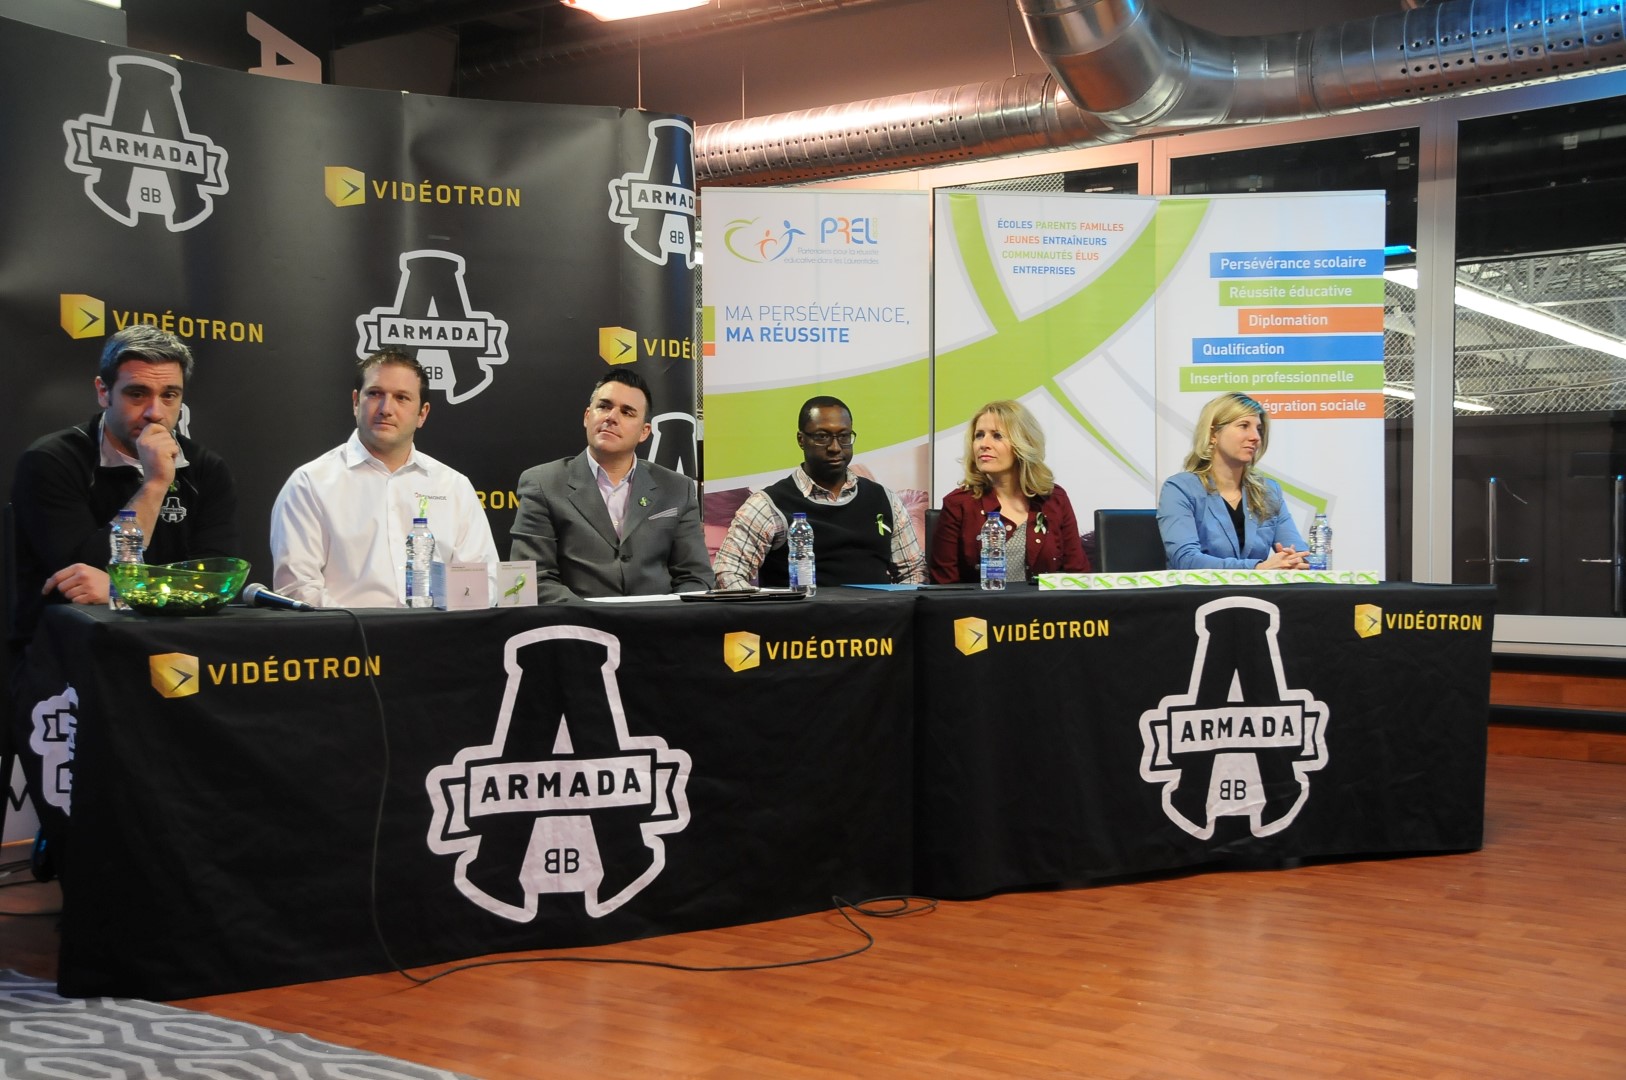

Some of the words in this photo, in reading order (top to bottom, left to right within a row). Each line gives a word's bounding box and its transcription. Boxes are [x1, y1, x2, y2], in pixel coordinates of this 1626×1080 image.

[99, 135, 198, 167] ARMADA
[140, 187, 162, 203] BB
[372, 179, 520, 207] VIDÉOTRON
[820, 217, 877, 244] PREL
[997, 218, 1033, 229] ÉCOLES
[1035, 221, 1077, 230] PARENTS
[1080, 222, 1124, 231] FAMILLES
[669, 230, 684, 244] BB
[1003, 235, 1040, 244] JEUNES
[1042, 235, 1107, 246] ENTRAÎNEURS
[1001, 249, 1073, 260] COMMUNAUTÉS
[1075, 251, 1099, 261] ÉLUS
[1220, 256, 1311, 270] Persévérance
[1314, 256, 1367, 269] scolaire
[1012, 265, 1076, 275] ENTREPRISES
[1229, 286, 1286, 298] Réussite
[1289, 285, 1353, 298] éducative
[725, 306, 753, 322] MA
[759, 302, 911, 325] PERSÉVÉRANCE,
[1248, 314, 1329, 328] Diplomation
[112, 310, 264, 343] VIDÉOTRON
[387, 323, 479, 342] ARMADA
[726, 327, 754, 342] MA
[760, 323, 850, 343] RÉUSSITE
[1202, 343, 1285, 356] Qualification
[1190, 372, 1249, 384] Insertion
[1252, 370, 1355, 385] professionnelle
[1319, 399, 1367, 411] sociale
[992, 618, 1110, 642] VIDÉOTRON
[1385, 610, 1482, 632] VIDÉOTRON
[766, 635, 894, 660] VIDÉOTRON
[208, 655, 381, 686] VIDÉOTRON
[1180, 715, 1295, 743] ARMADA
[480, 767, 642, 804] ARMADA
[1219, 779, 1246, 801] BB
[544, 847, 580, 874] BB
